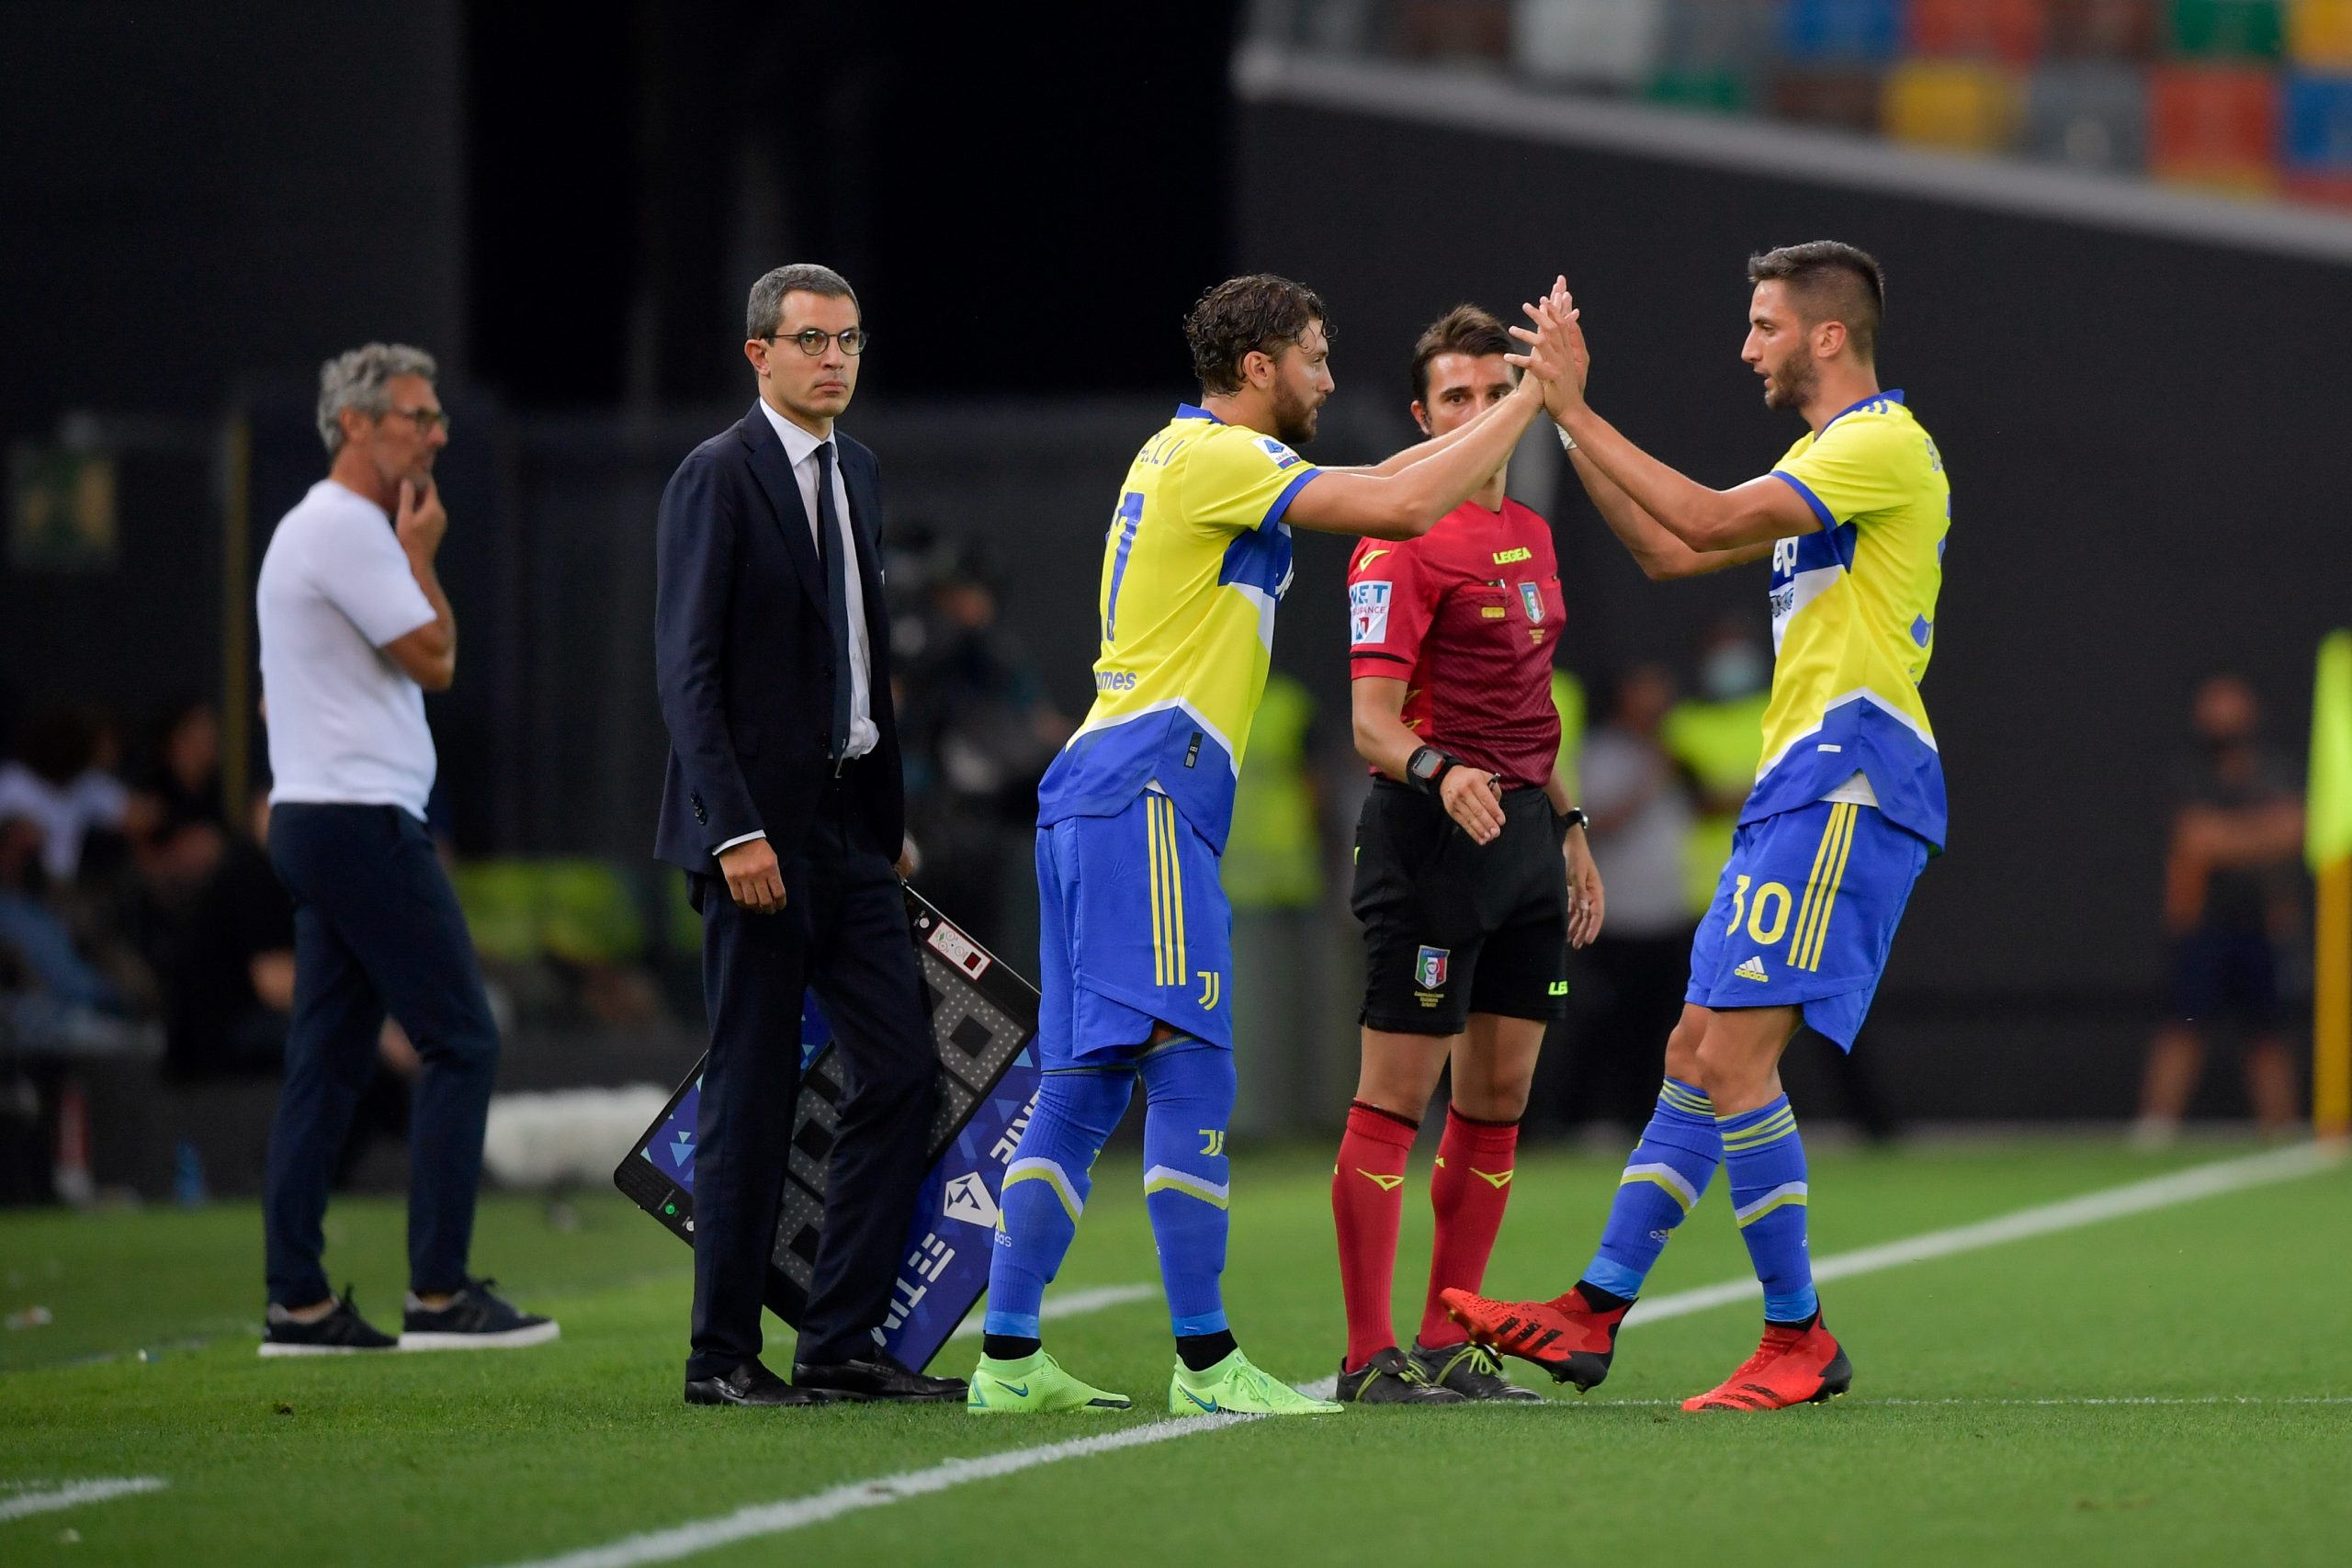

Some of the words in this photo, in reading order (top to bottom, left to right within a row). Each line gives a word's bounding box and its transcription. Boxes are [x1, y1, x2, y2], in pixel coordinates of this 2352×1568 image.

[1492, 547, 1532, 565] LEGEA
[1101, 492, 1145, 642] 7
[1095, 671, 1137, 691] ames
[1726, 874, 1792, 944] 30
[1734, 967, 1769, 983] adidas
